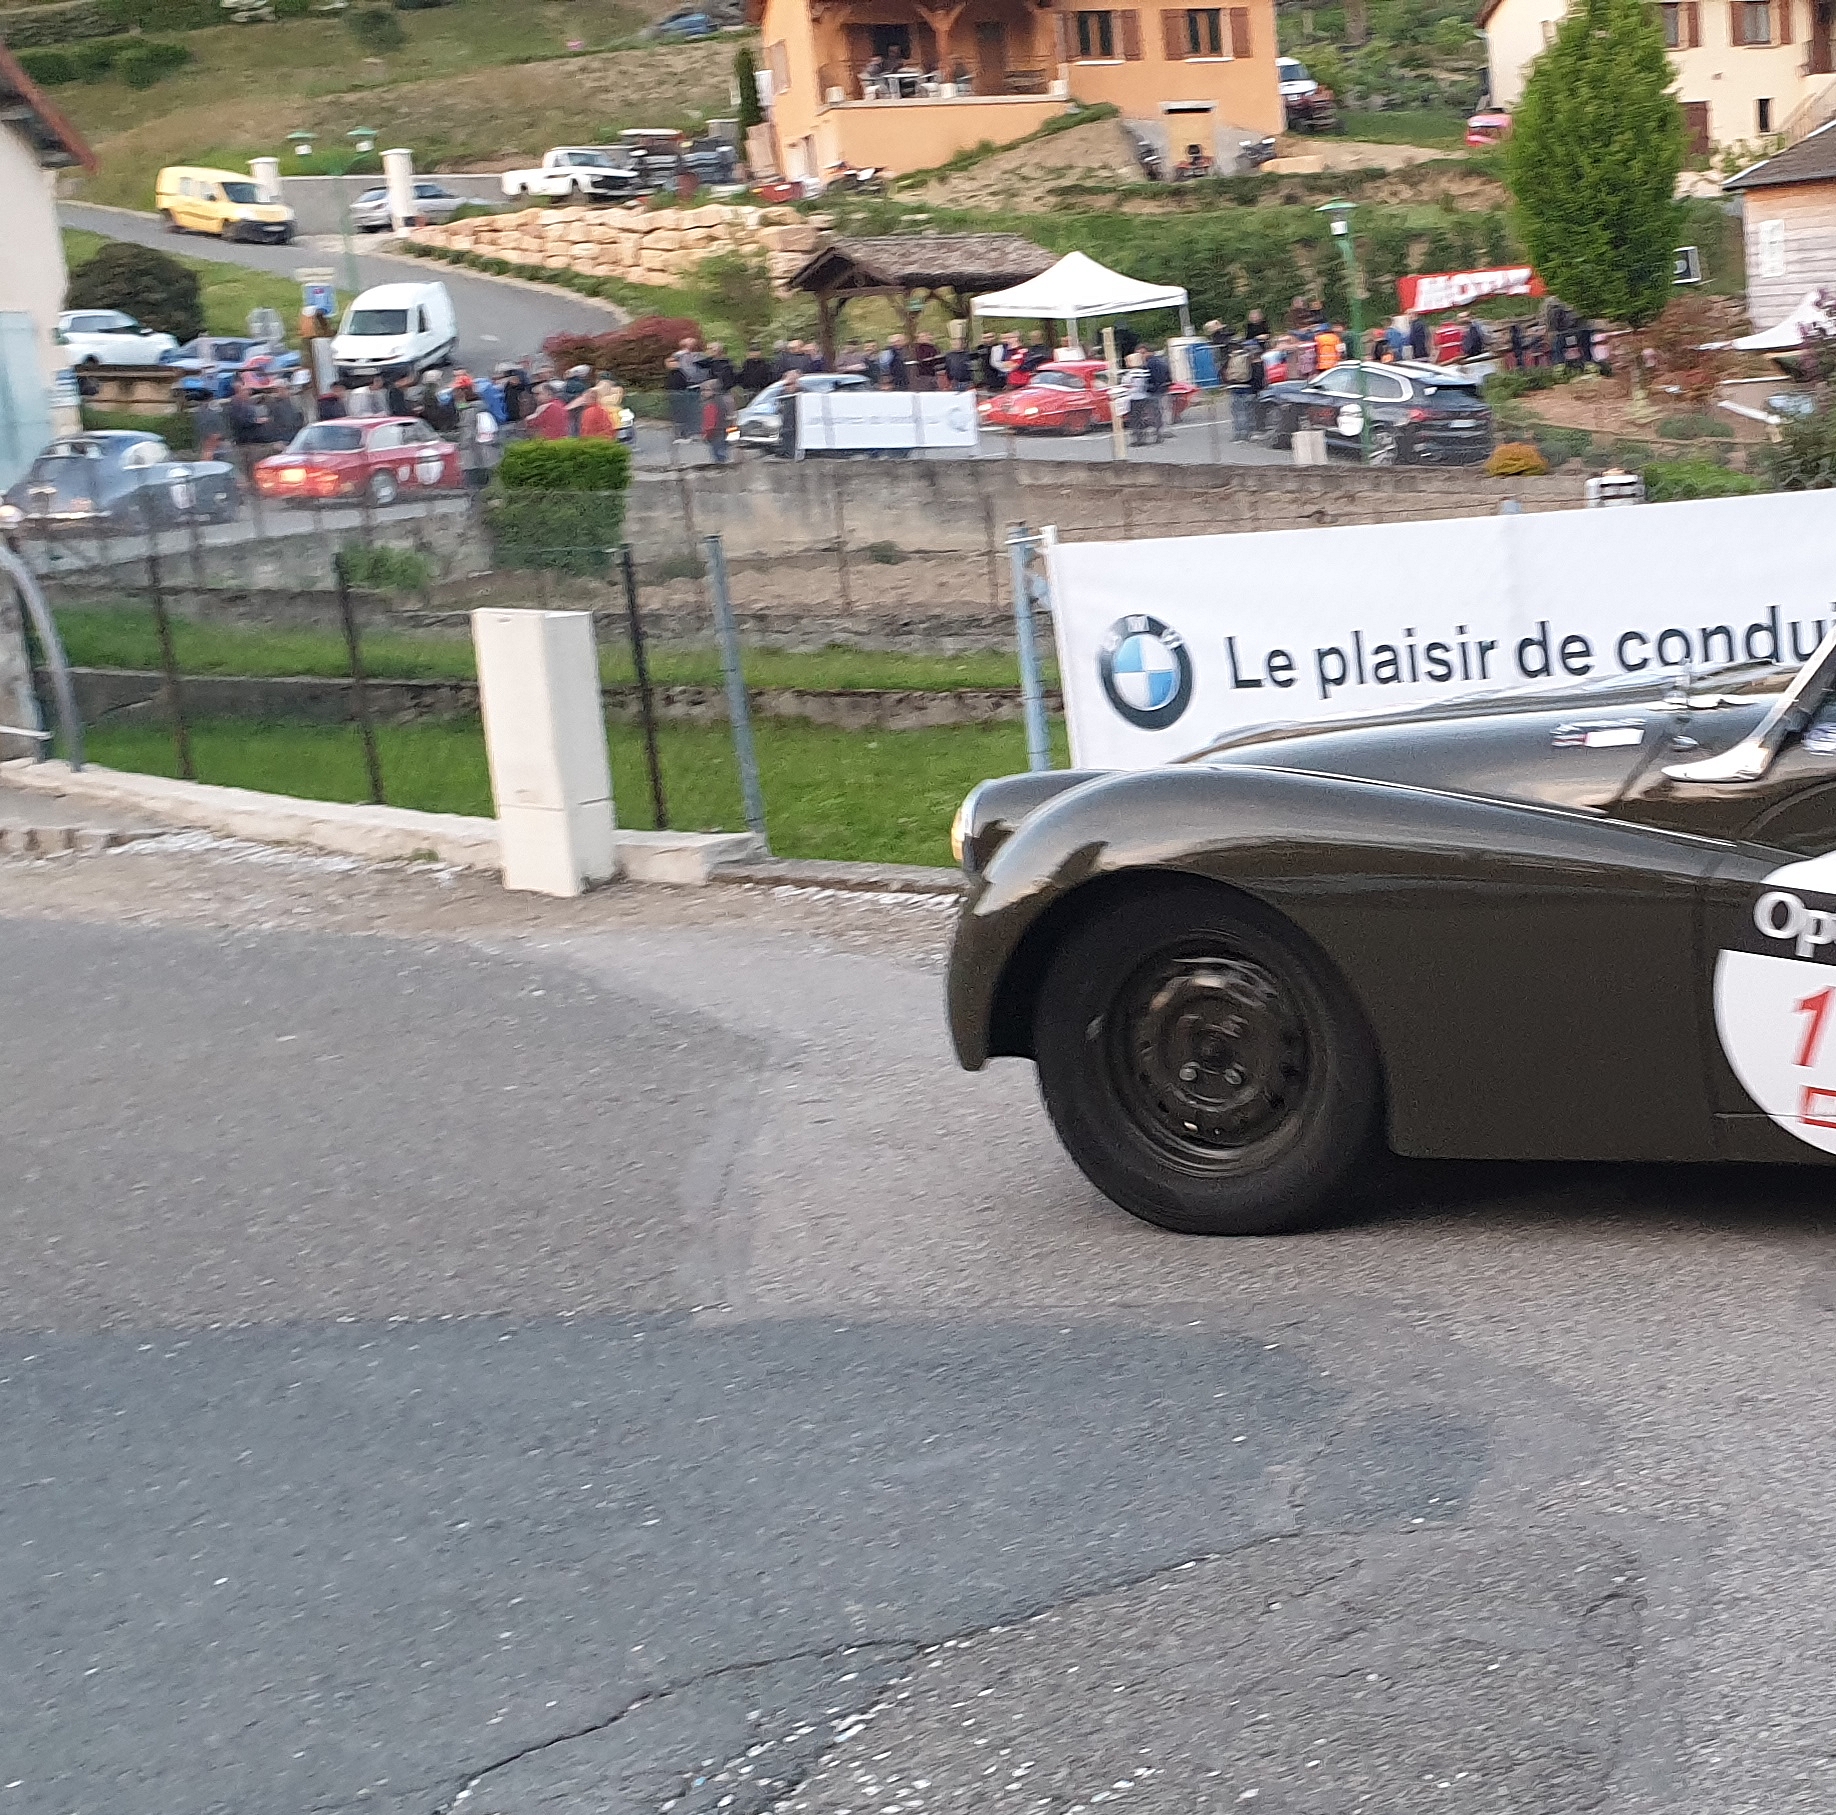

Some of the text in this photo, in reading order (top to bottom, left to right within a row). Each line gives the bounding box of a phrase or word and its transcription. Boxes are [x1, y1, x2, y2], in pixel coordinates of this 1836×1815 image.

[1224, 635, 1298, 689] Le
[1314, 624, 1497, 700] plaisir
[1518, 620, 1596, 679] de
